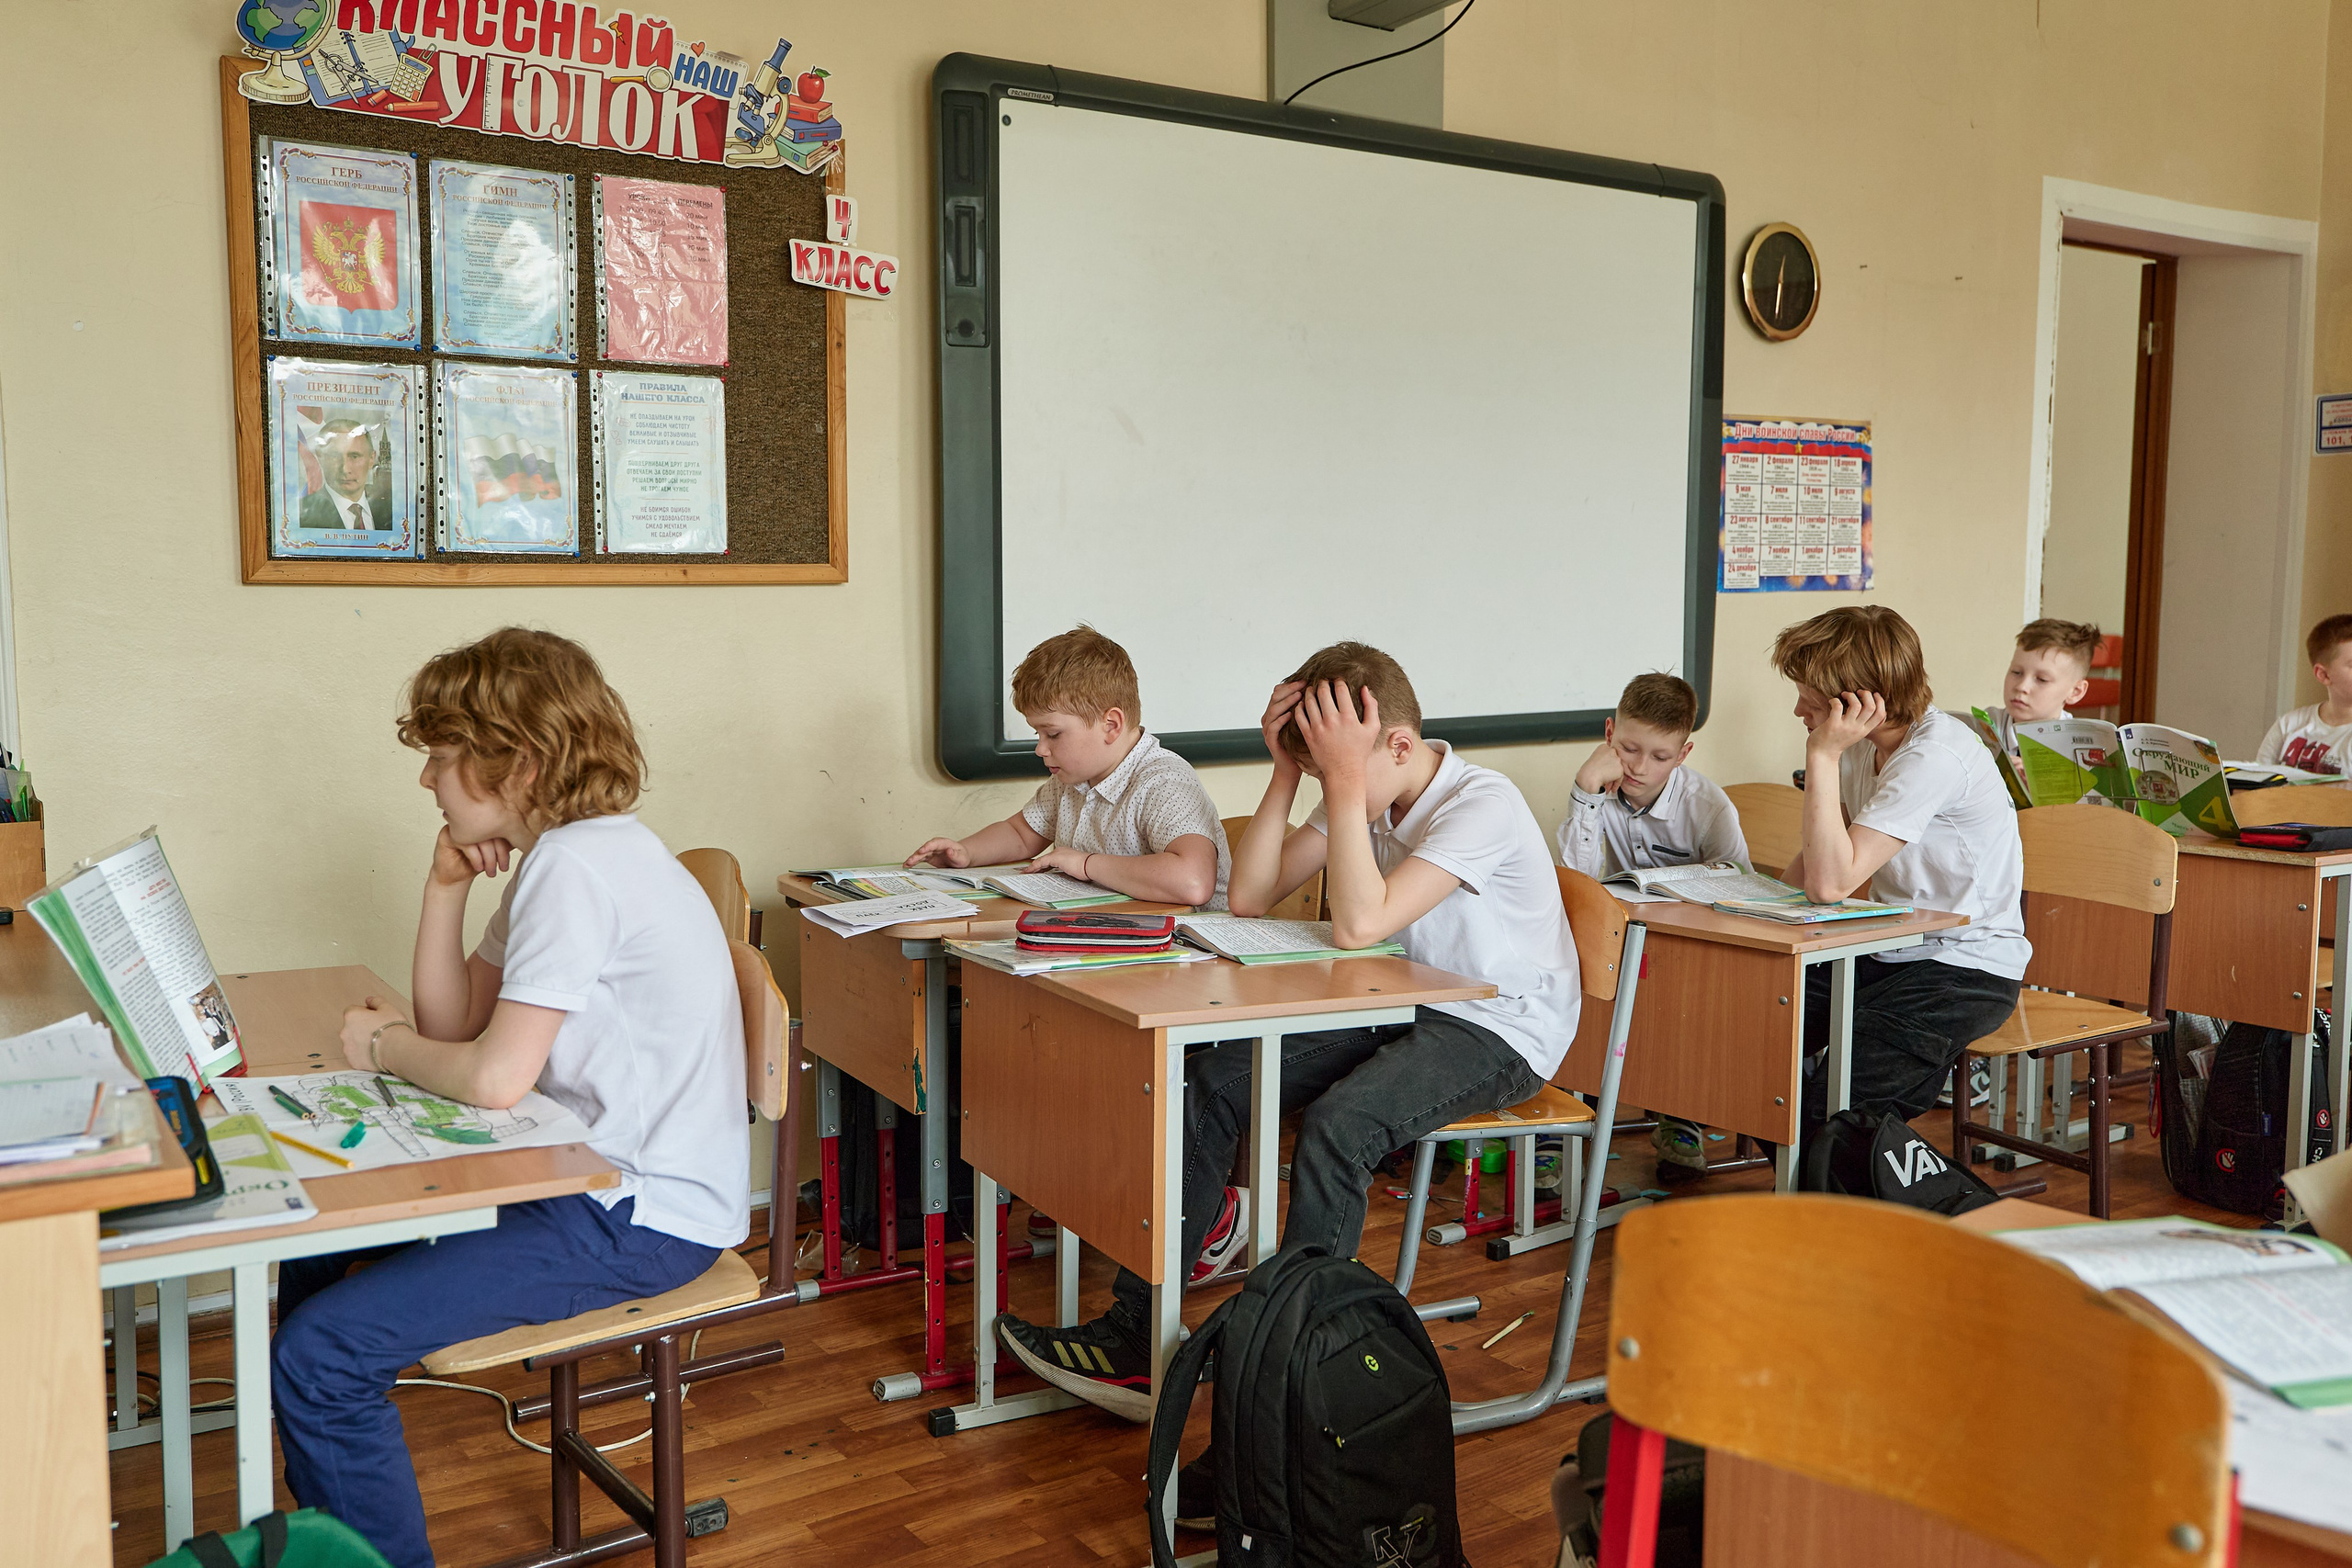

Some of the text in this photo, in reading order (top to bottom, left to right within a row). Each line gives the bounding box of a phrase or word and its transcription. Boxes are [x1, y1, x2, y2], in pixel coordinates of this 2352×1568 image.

[337, 0, 673, 69] КЛАССНЫЙ
[675, 52, 740, 98] НАШ
[1011, 89, 1051, 100] PROMETHEAN
[438, 51, 706, 160] УГОЛОК
[331, 166, 363, 178] ГЕРБ
[296, 175, 398, 193] РОССИЙСКОЙ ФЕДЕРАЦИИ
[483, 185, 517, 197] ГИМН
[678, 198, 713, 209] ПЕРЕМЕНЫ
[835, 198, 852, 240] 4
[794, 243, 897, 296] КЛАСС
[306, 381, 381, 396] ПРЕЗИДЕНТ
[639, 382, 687, 392] ПРАВИЛА
[292, 393, 395, 407] РОССИЙСКОЙ ФЕДЕРАЦИИ
[620, 392, 706, 403] НАШЕГО КЛАССА
[1735, 423, 1855, 441] Дни воинской славы России
[2132, 748, 2211, 773] Окружающий
[2164, 760, 2199, 780] МИР
[2198, 795, 2234, 831] 4
